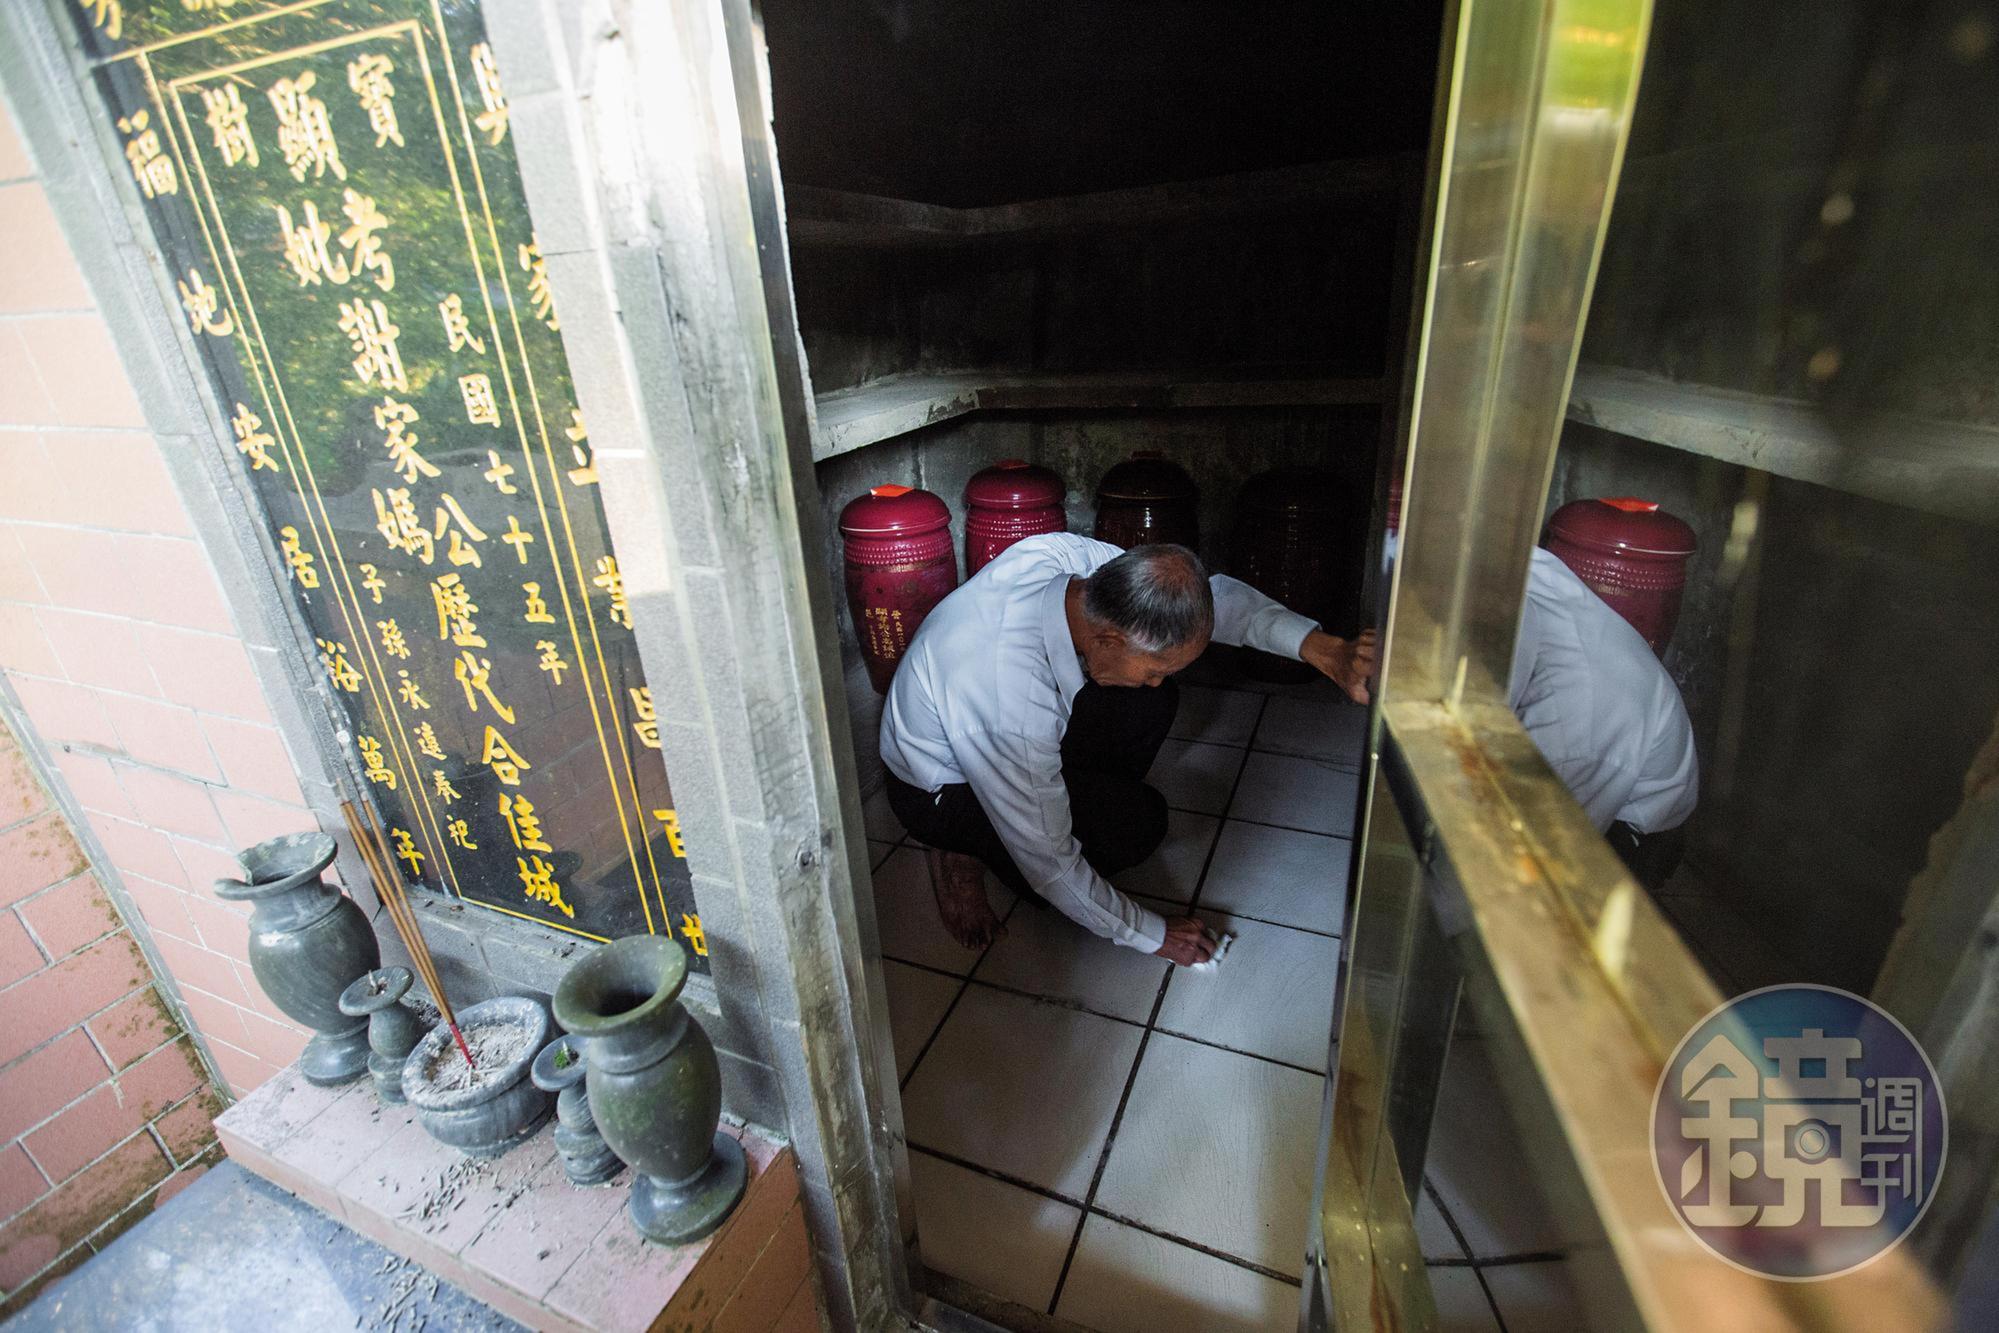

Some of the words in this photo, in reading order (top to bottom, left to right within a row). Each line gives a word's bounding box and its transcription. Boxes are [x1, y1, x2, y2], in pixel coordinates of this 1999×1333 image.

[347, 53, 404, 148] 寶
[438, 293, 569, 685] 民國七十五年
[360, 563, 478, 850] 子孫永遠奉祀
